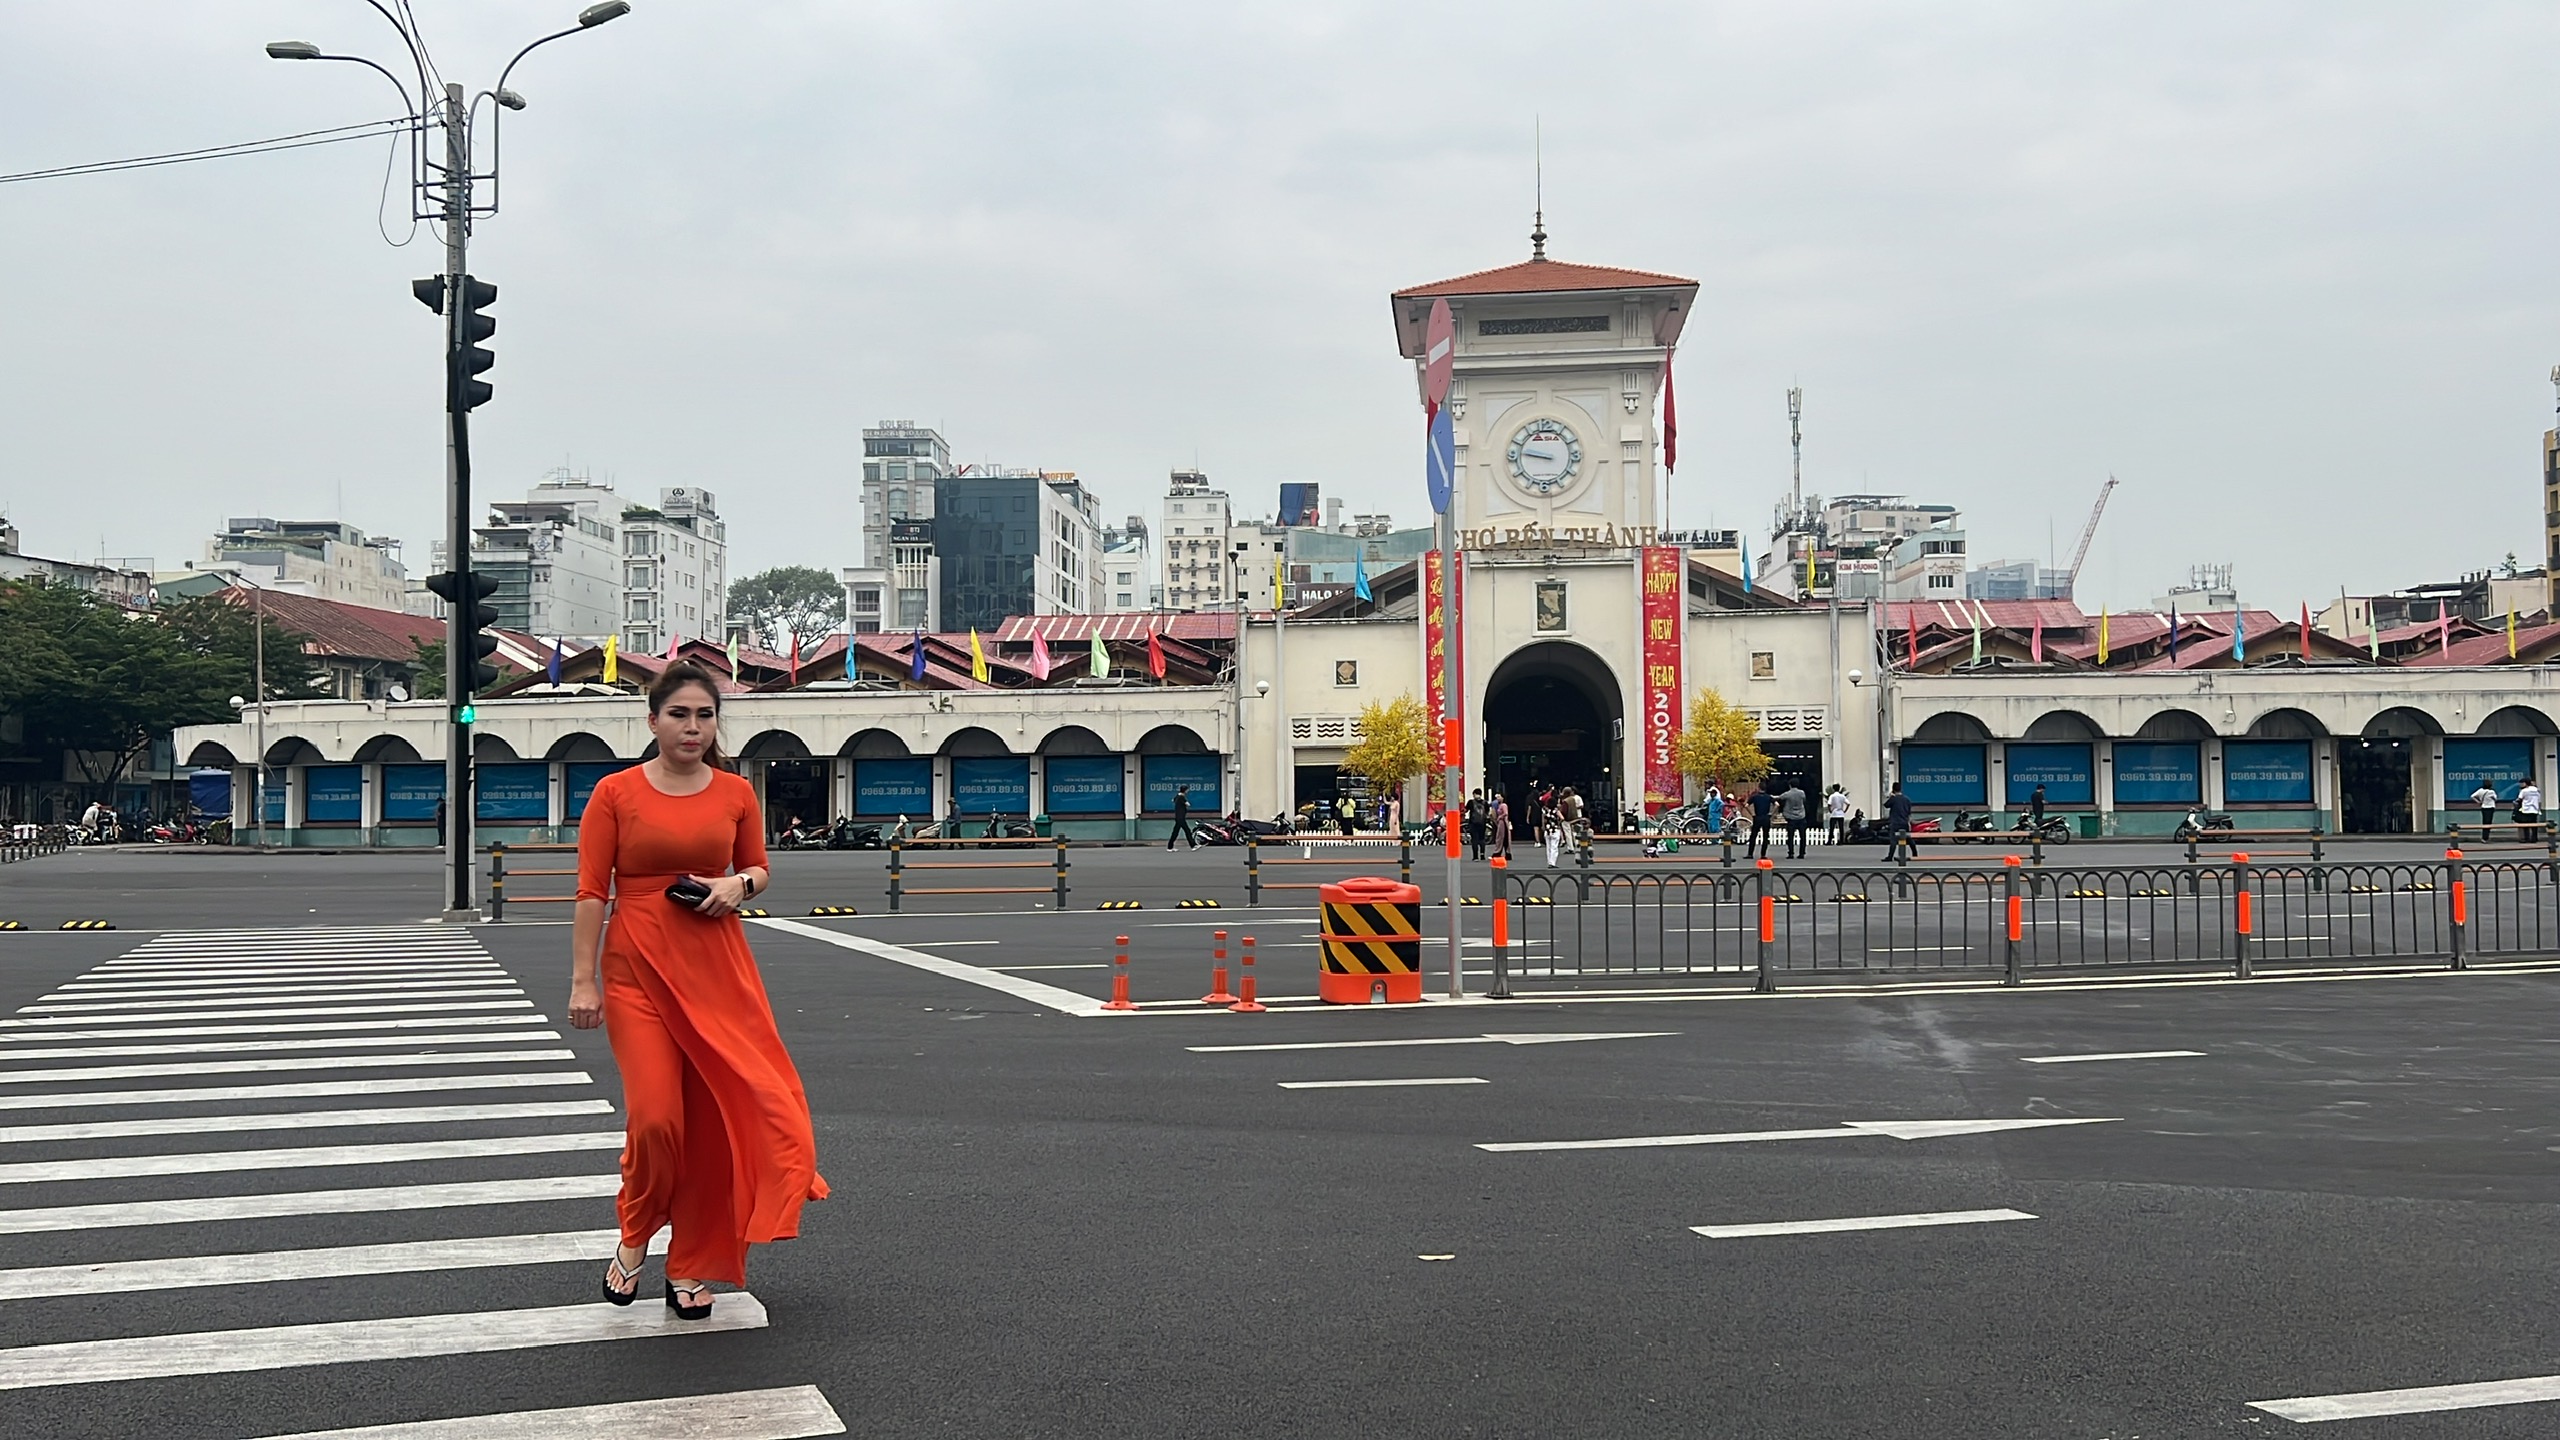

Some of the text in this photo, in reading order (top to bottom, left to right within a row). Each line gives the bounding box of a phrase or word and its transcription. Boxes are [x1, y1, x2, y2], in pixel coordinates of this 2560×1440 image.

[1507, 450, 1519, 463] 9
[1570, 450, 1582, 463] 3
[1539, 481, 1550, 493] 6
[1505, 521, 1555, 550] BẾN
[1564, 521, 1658, 549] THÀNH
[1646, 572, 1678, 594] HAPPY
[1302, 590, 1332, 600] HALO
[1650, 618, 1673, 641] NEW
[1650, 665, 1677, 690] YEAR
[1653, 693, 1670, 765] 2023
